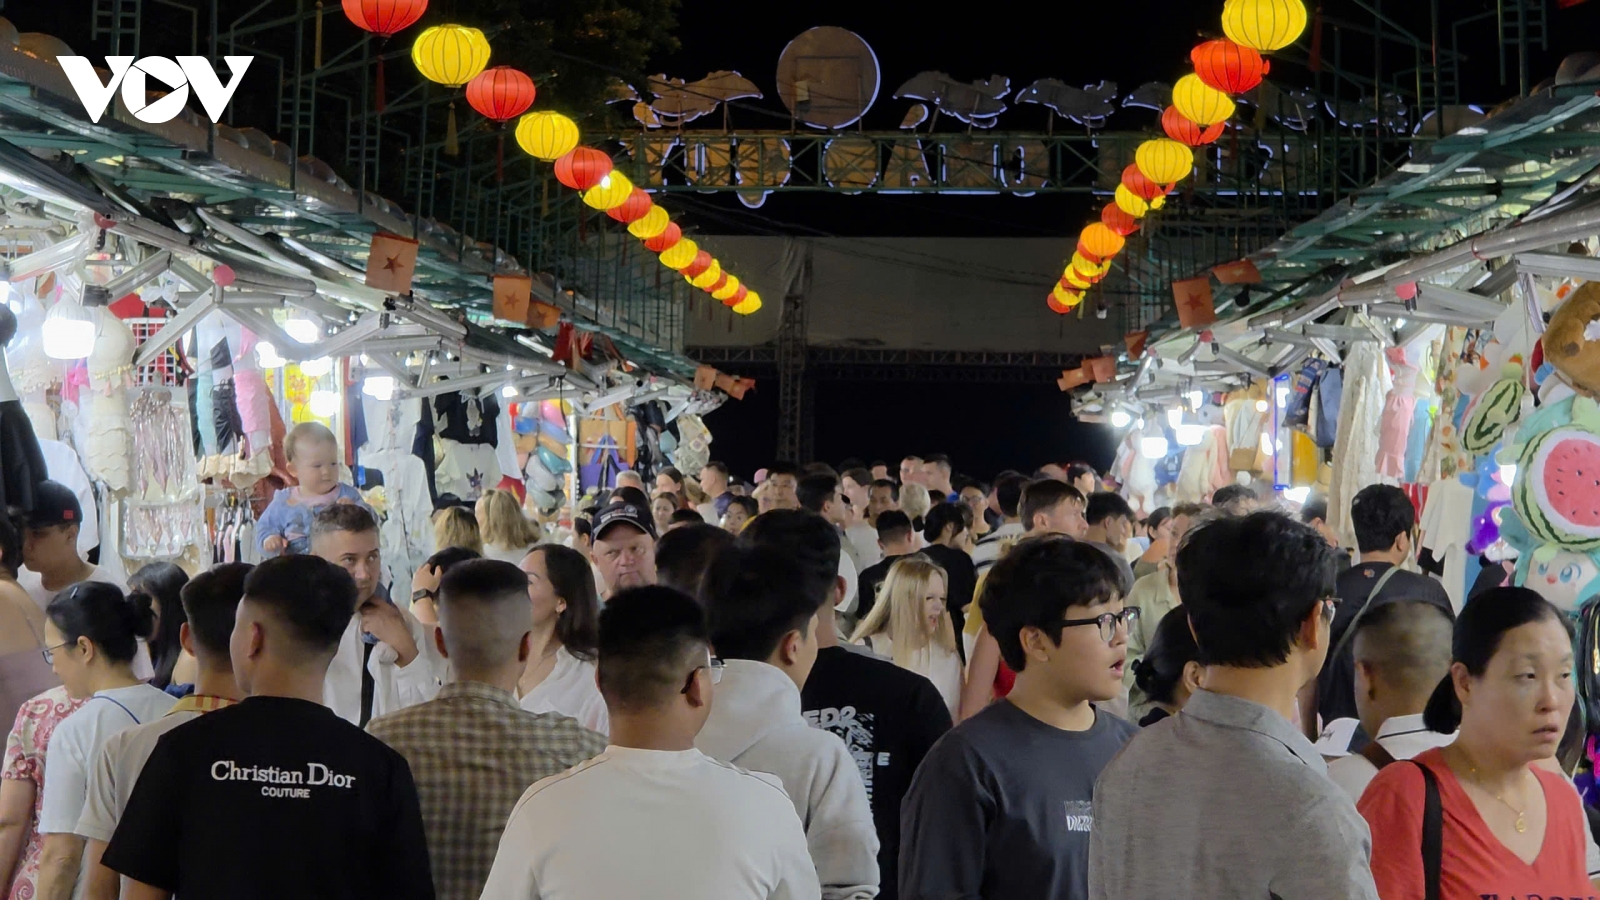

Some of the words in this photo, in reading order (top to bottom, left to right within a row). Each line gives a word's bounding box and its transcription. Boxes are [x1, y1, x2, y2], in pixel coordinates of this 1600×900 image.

[211, 760, 303, 784] Christian
[307, 763, 356, 788] Dior
[261, 786, 311, 798] COUTURE
